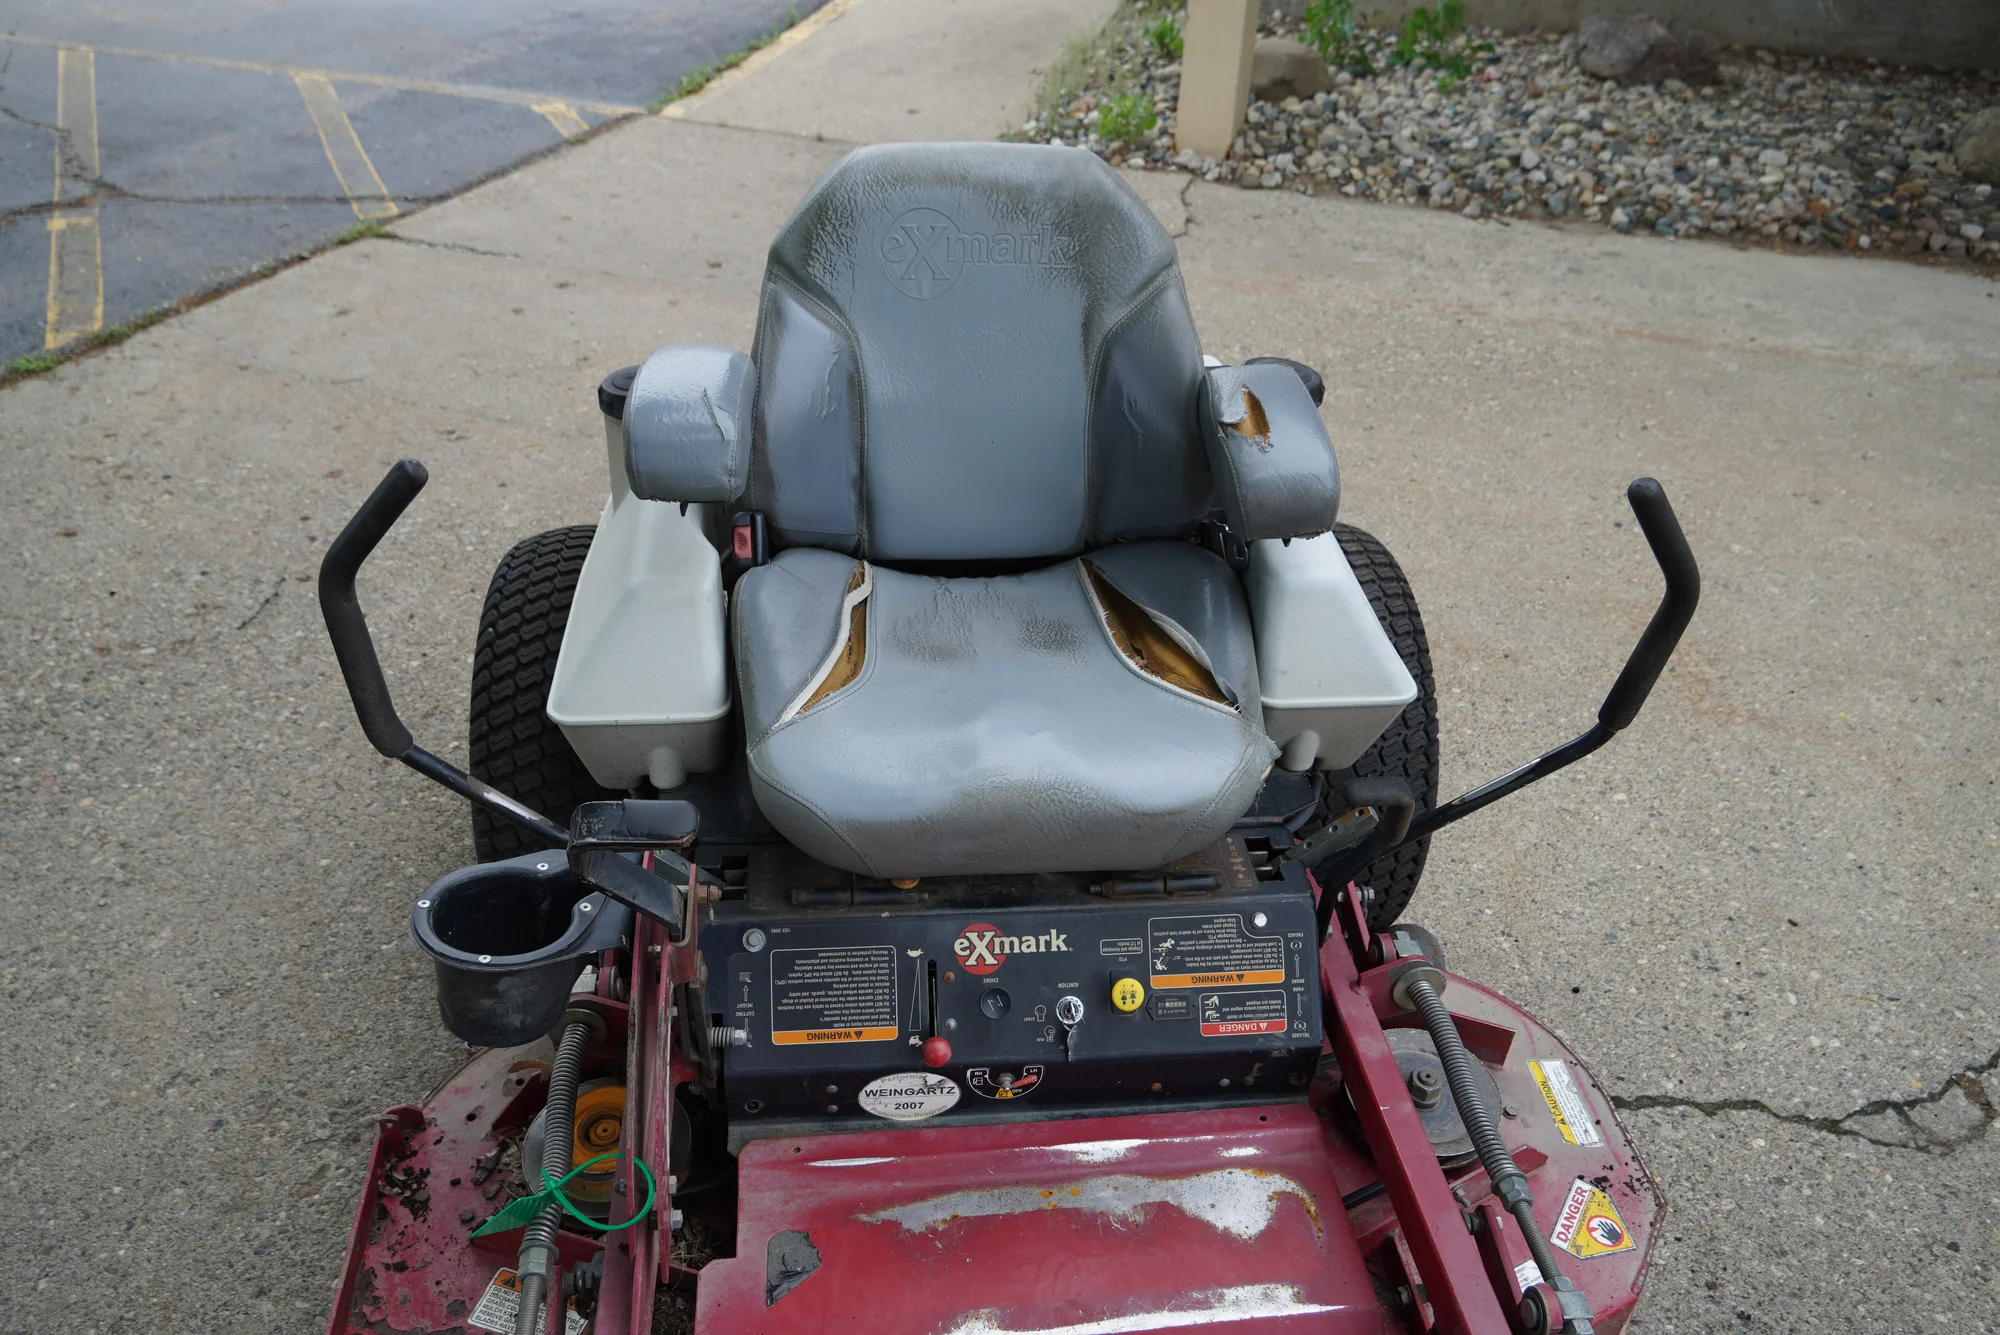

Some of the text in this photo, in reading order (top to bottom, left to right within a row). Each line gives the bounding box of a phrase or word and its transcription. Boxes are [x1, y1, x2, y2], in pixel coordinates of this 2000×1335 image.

[883, 224, 1069, 280] eXmark
[954, 929, 1069, 966] eXmark
[1191, 975, 1234, 983] WARNING
[1219, 1023, 1257, 1032] DANGER
[806, 1032, 852, 1040] WARNING
[865, 1087, 956, 1097] WEINGARTZ
[1539, 1080, 1561, 1117] CAUTION
[870, 1104, 948, 1118] Protection Program
[1556, 1186, 1587, 1243] DANGER
[486, 1298, 505, 1307] GRASS
[489, 1293, 520, 1305] DISCHARG
[482, 1304, 503, 1313] MULCH
[479, 1309, 503, 1320] REMOVE
[475, 1314, 515, 1331] BLADES HAVE
